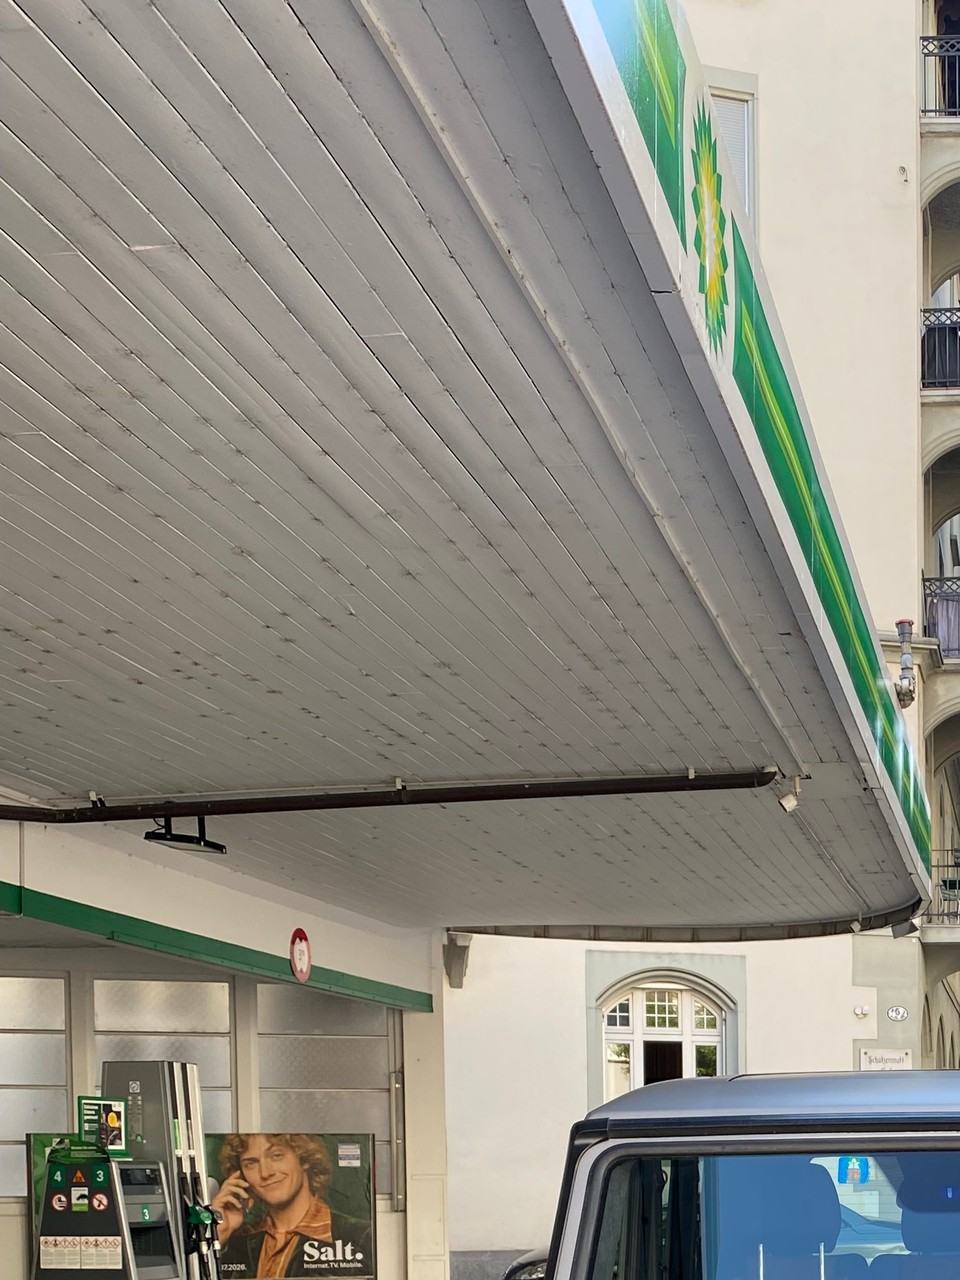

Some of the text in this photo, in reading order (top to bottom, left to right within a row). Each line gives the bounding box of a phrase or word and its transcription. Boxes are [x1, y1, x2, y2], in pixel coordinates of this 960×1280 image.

[53, 1170, 62, 1182] 4
[96, 1170, 105, 1182] 3
[143, 1208, 150, 1221] 3
[303, 1239, 364, 1262] Salt.
